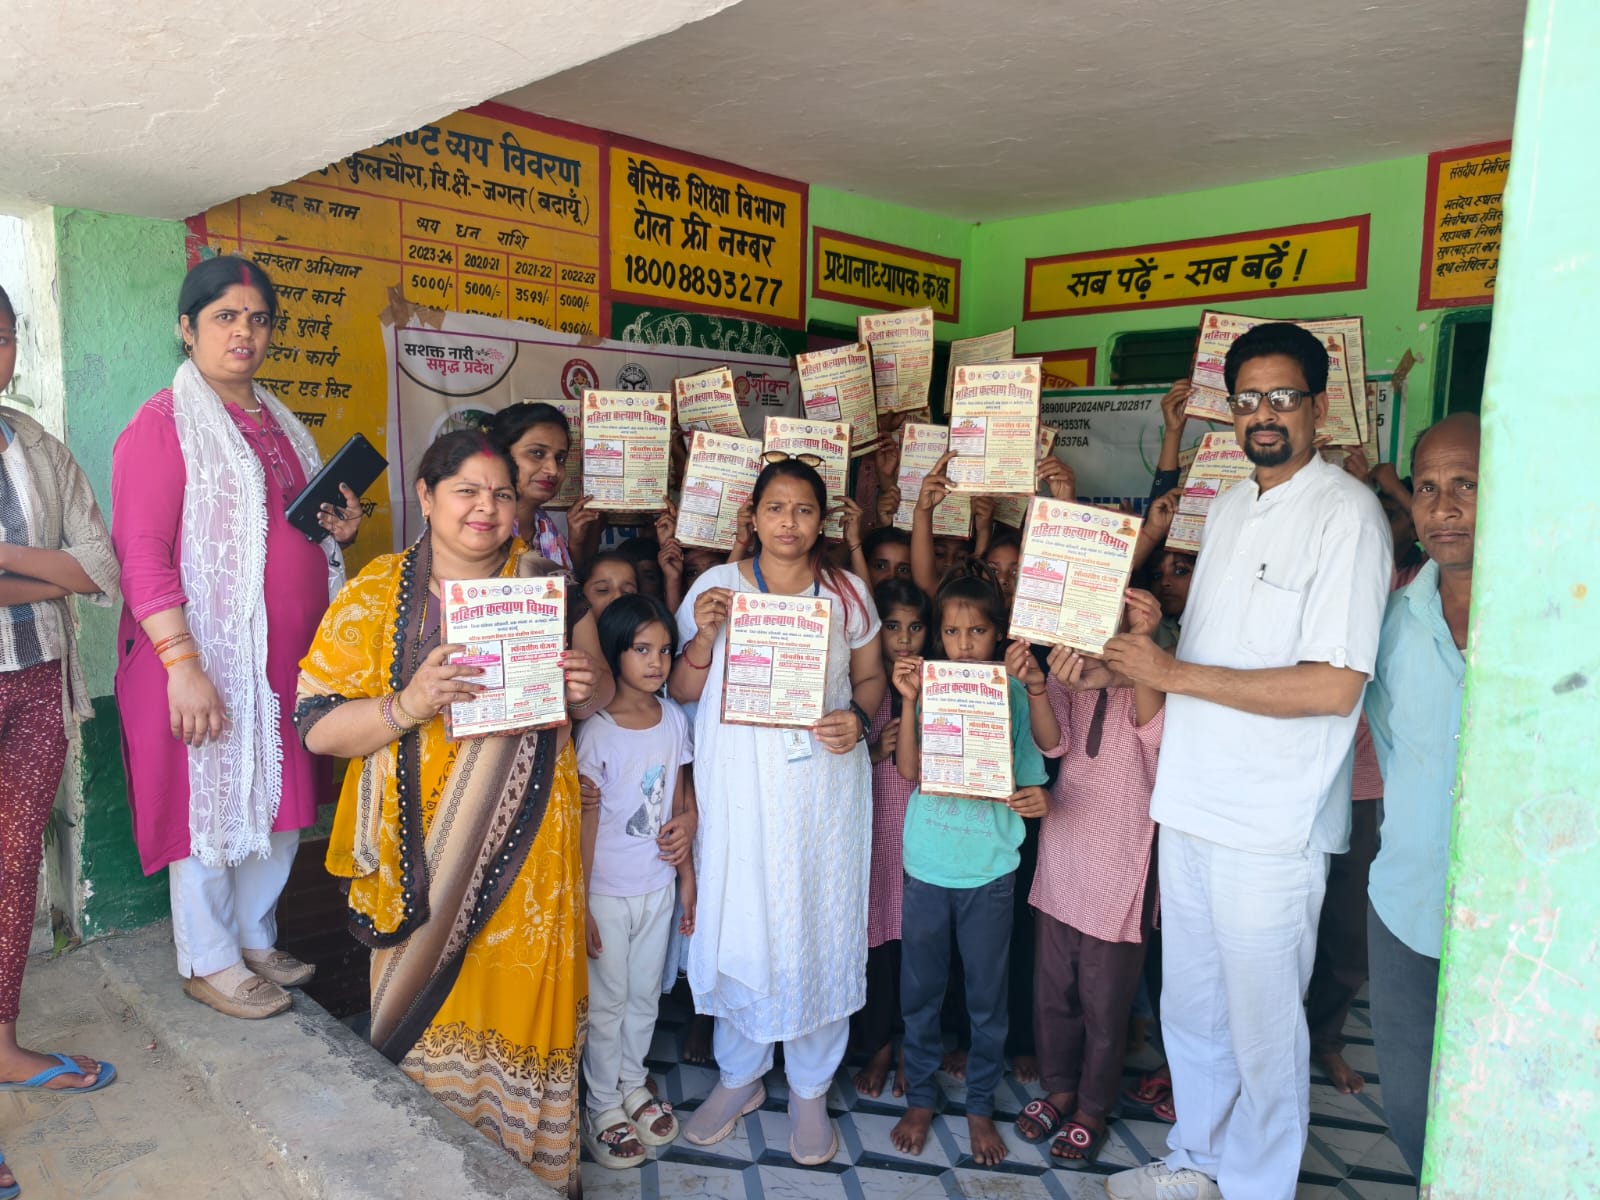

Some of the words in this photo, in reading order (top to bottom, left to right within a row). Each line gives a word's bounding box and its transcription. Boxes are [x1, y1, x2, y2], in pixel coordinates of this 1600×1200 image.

[445, 129, 493, 168] व्यय
[499, 131, 581, 188] विवरण
[627, 157, 681, 203] बेसिक
[686, 173, 731, 218] शिक्षा
[735, 183, 787, 229] विभाग
[329, 202, 361, 220] नाम
[417, 216, 441, 234] व्यय
[497, 229, 529, 250] राशि
[633, 199, 675, 247] टोल
[681, 212, 712, 252] फ्री
[718, 226, 776, 269] नम्बर
[305, 256, 363, 279] अभियान
[1066, 270, 1112, 298] सब
[1117, 257, 1159, 301] पढ़ें
[1184, 255, 1238, 287] सब
[824, 250, 920, 298] प्रधानाध्यापक
[921, 272, 951, 310] कक्ष
[311, 287, 347, 307] कार्य
[305, 346, 341, 367] कार्य
[404, 343, 445, 359] सशक्त
[448, 346, 474, 361] नारी
[426, 358, 460, 376] समृद्ध
[464, 359, 494, 375] प्रदेश
[325, 377, 353, 398] किट
[1032, 522, 1063, 538] महिला
[1063, 524, 1098, 543] कल्याण
[1100, 529, 1129, 553] विभाग
[450, 604, 484, 624] महिला
[485, 600, 523, 616] कल्याण
[526, 598, 559, 618] विभाग
[735, 613, 762, 629] महिला
[763, 613, 796, 628] कल्याण
[797, 615, 825, 635] विभाग
[926, 681, 951, 698] महिला
[951, 681, 979, 697] कल्याण
[980, 682, 1004, 700] विभाग
